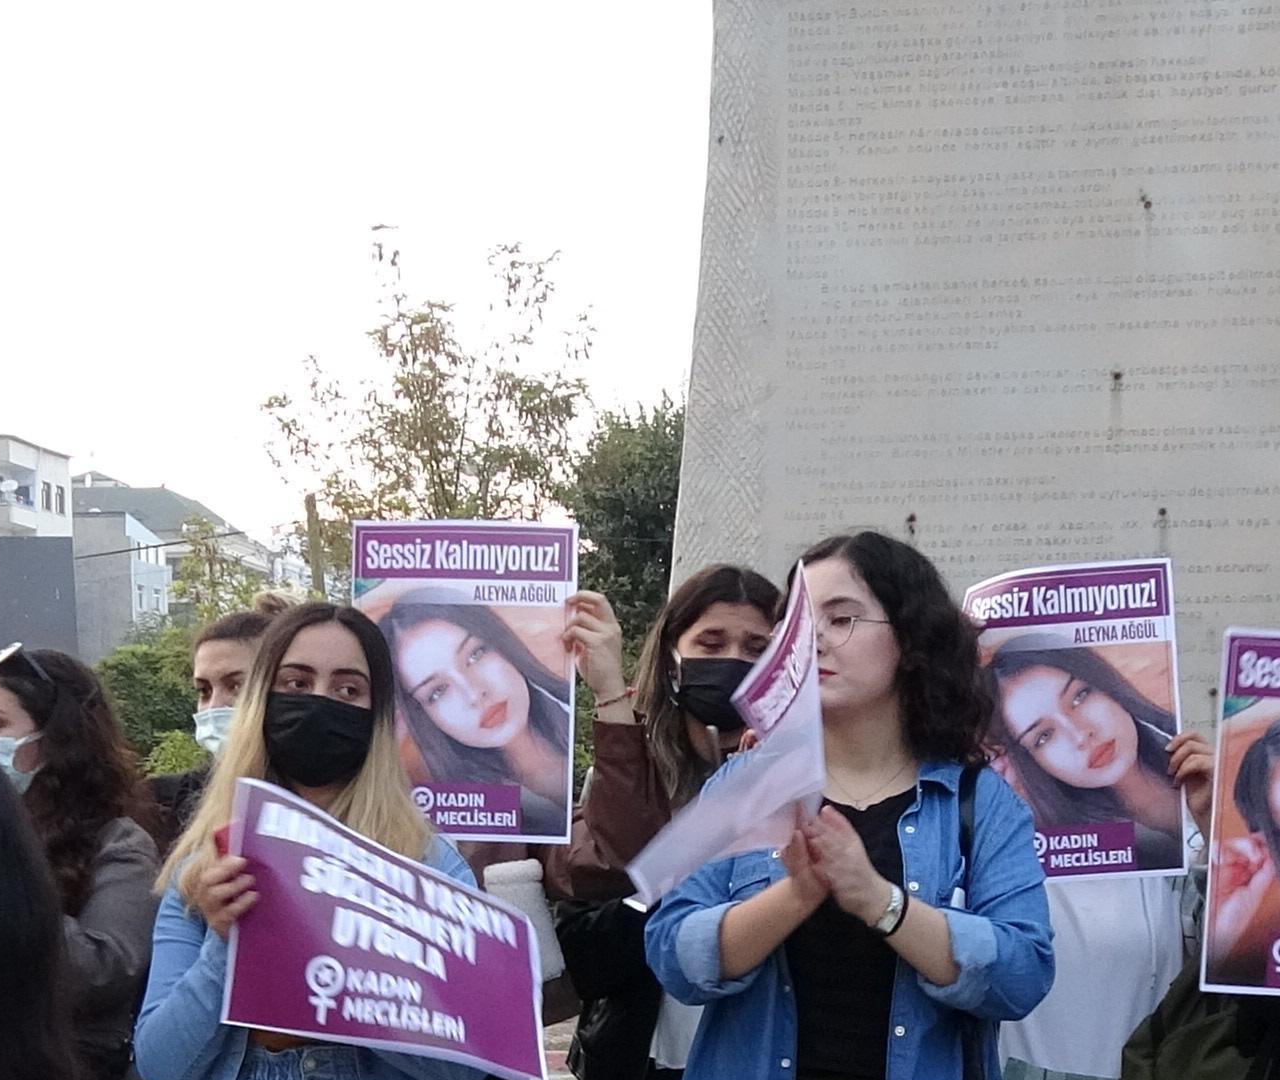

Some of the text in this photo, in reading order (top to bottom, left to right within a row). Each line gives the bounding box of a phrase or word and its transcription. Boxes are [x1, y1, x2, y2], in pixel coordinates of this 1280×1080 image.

[366, 539, 560, 574] Sessiz Kalmıyoruz!
[473, 584, 558, 603] ALEYNA AĞGÜL
[1033, 578, 1157, 616] Kalmıyoruz!
[1074, 620, 1159, 644] ALEYNA AĞGÜL
[437, 792, 485, 808] KADIN
[437, 808, 517, 827] MECLİSLERİ
[1048, 833, 1098, 851] KADIN
[1049, 846, 1133, 868] MECLİSLERİ
[345, 966, 423, 1001] KADIN
